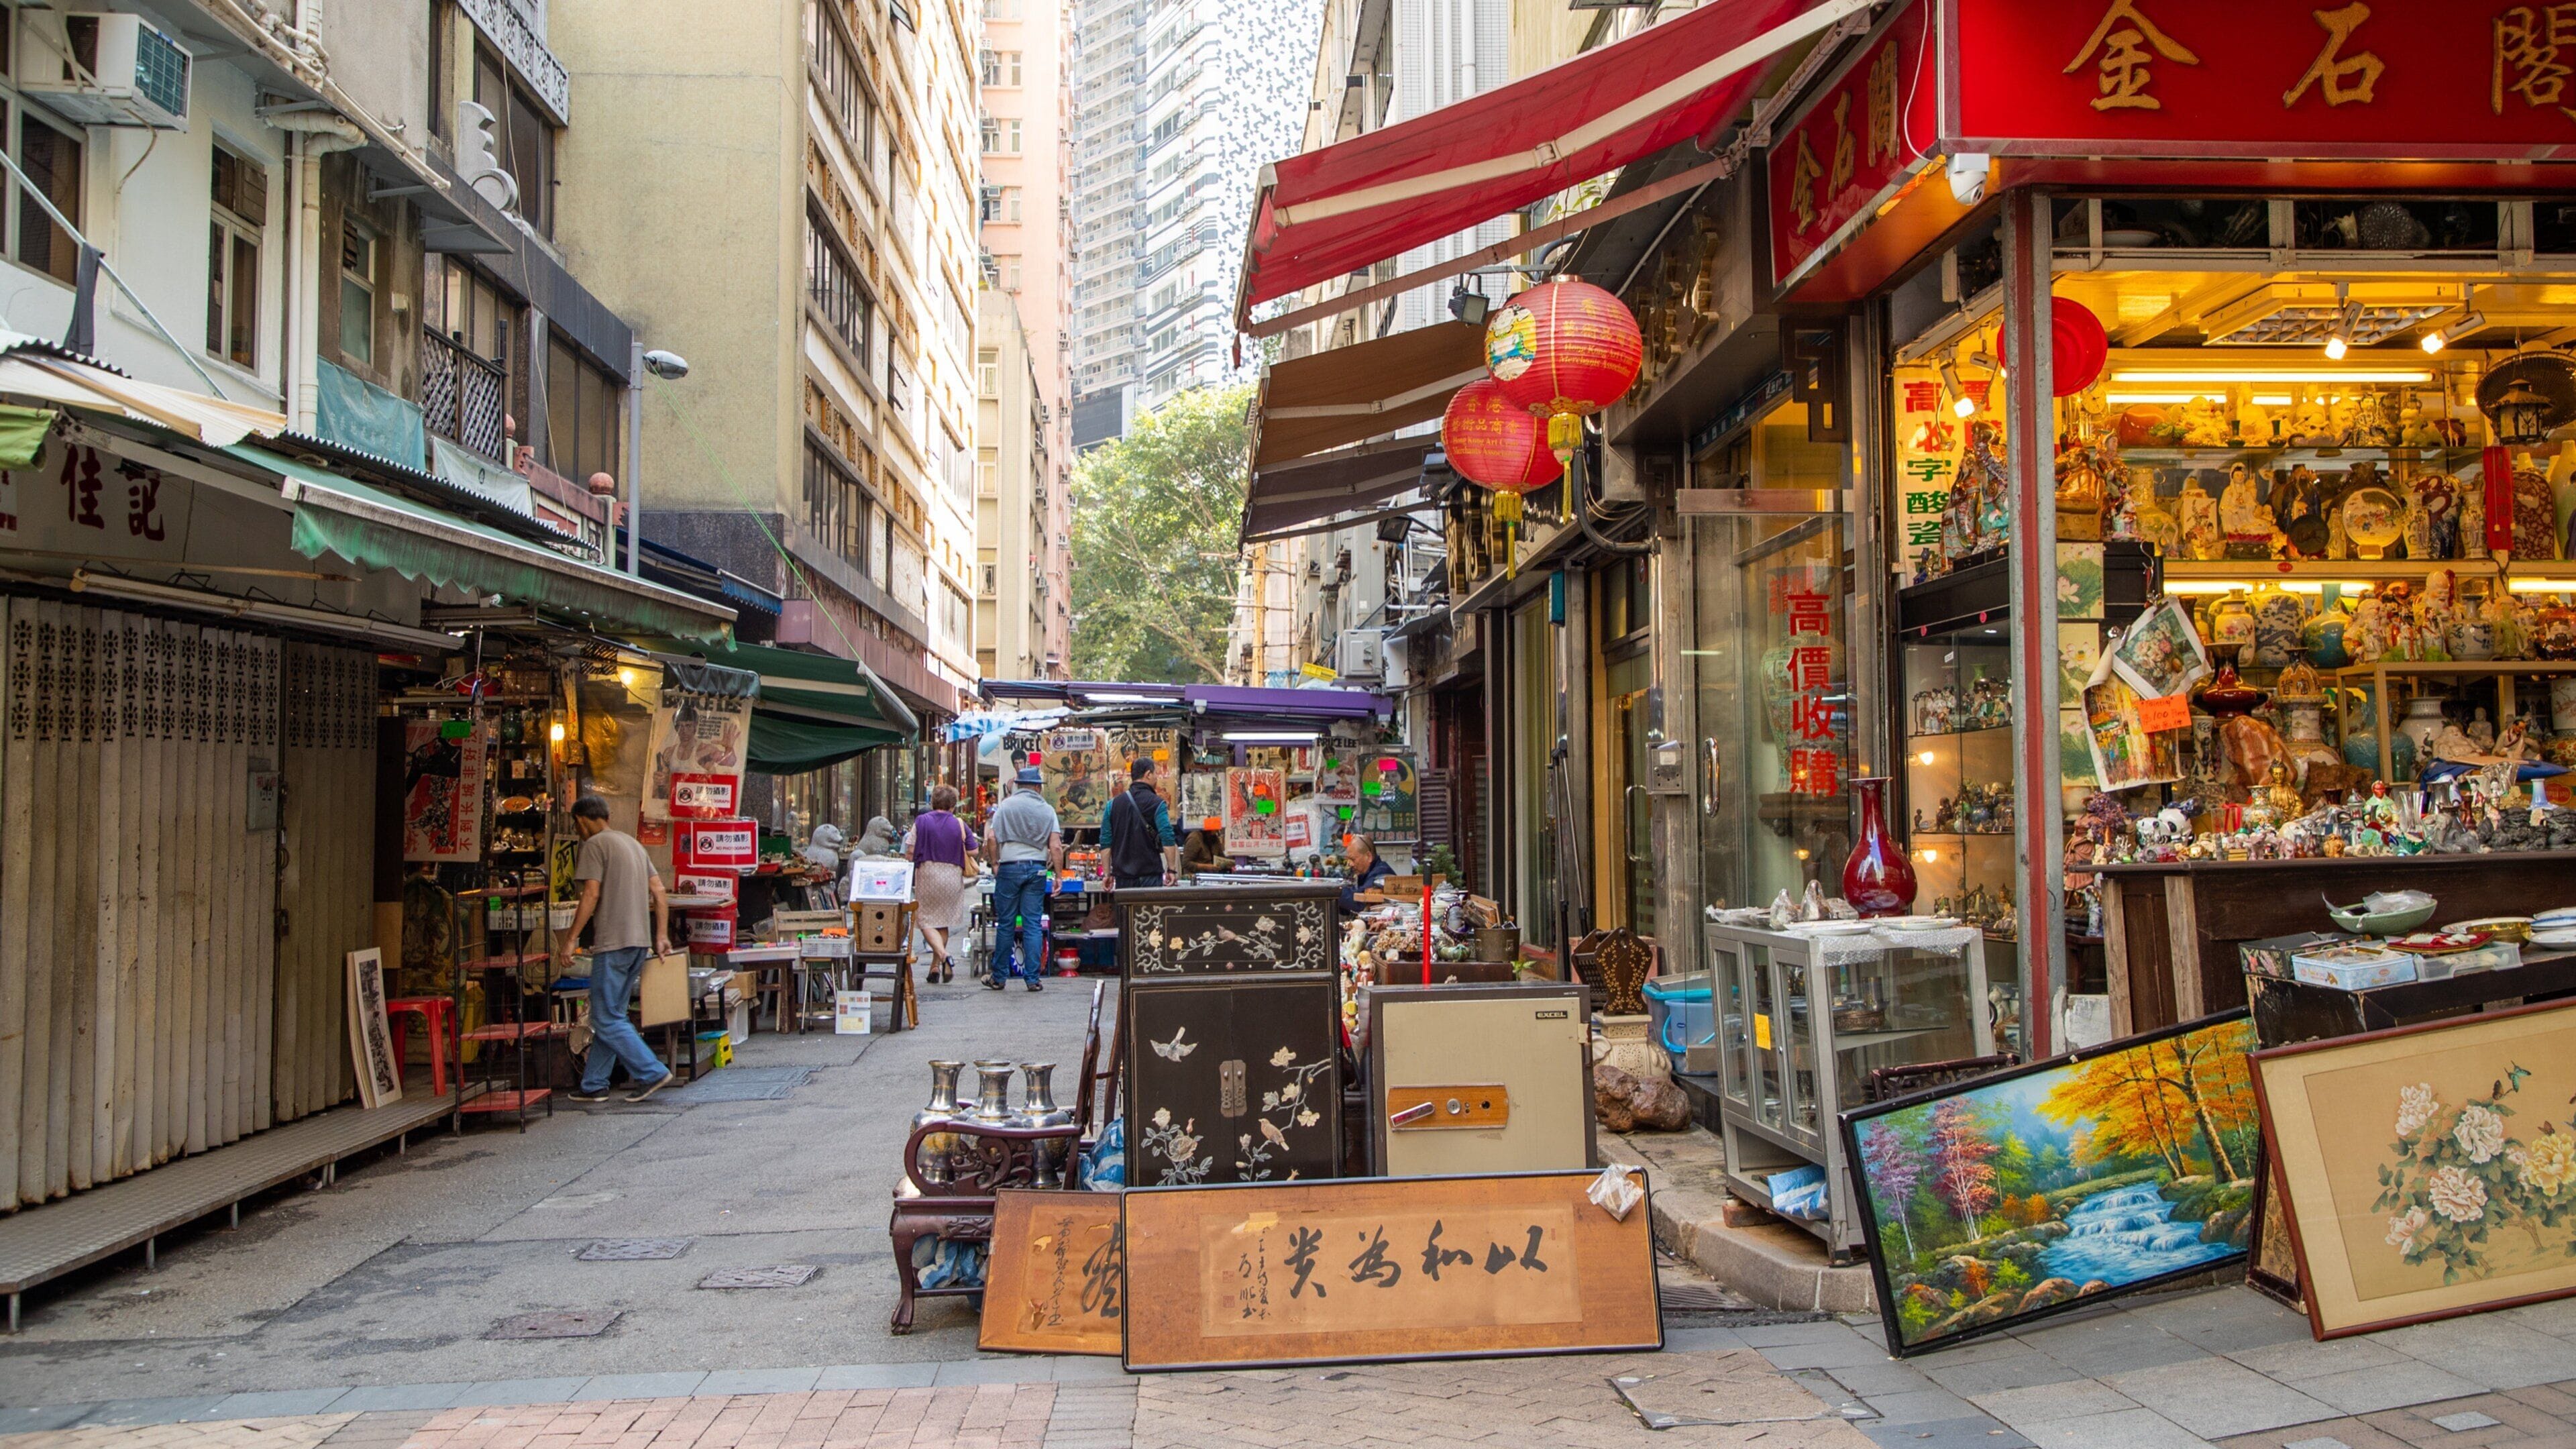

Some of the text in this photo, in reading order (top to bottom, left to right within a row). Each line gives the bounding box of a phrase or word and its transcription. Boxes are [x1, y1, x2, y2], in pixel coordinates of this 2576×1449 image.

[2062, 0, 2576, 122] 金石閣
[1790, 40, 1900, 236] 金石閣
[1564, 343, 1586, 355] Hong
[1588, 345, 1607, 358] Kong
[1560, 356, 1600, 366] Merchants
[1466, 394, 1505, 413] 香港
[1452, 416, 1521, 435] 藝術品商會
[1453, 436, 1466, 445] Hong
[1468, 437, 1484, 446] Kong
[1453, 446, 1481, 455] Merchants
[60, 443, 165, 541] 佳記
[1786, 590, 1839, 798] 高價收購
[1003, 737, 1034, 751] BRUCE
[1344, 739, 1356, 748] LEE
[716, 834, 749, 843] 請勿攝影
[698, 878, 730, 888] 請勿攝影
[695, 921, 728, 931] 請勿攝影
